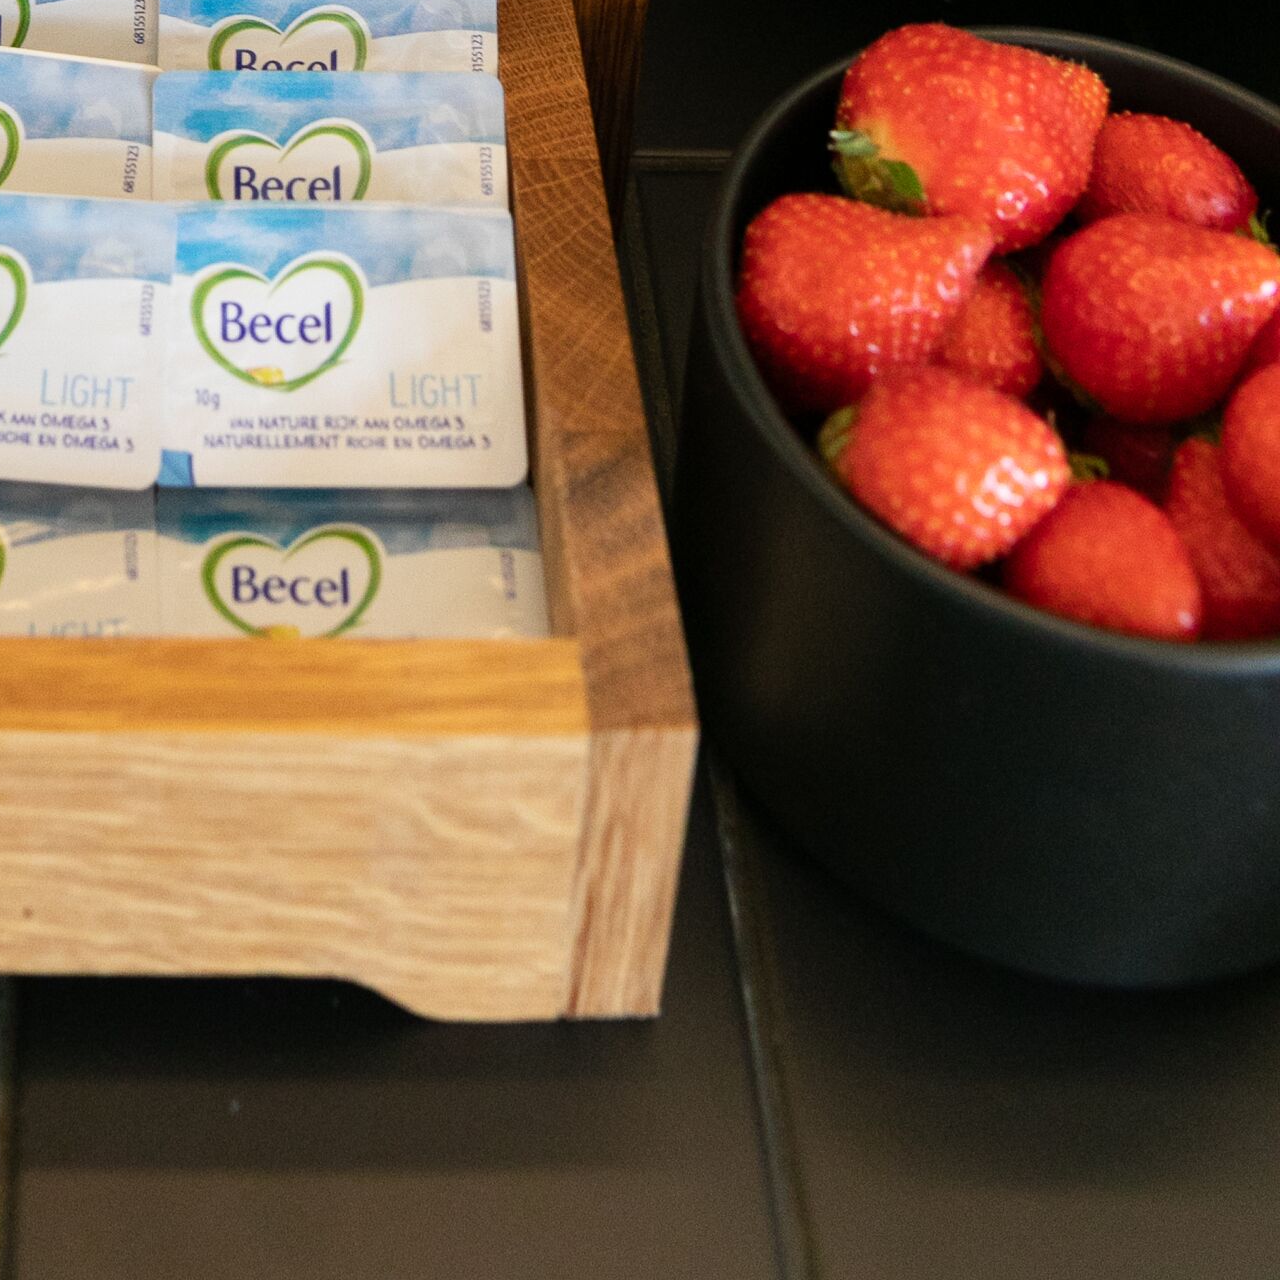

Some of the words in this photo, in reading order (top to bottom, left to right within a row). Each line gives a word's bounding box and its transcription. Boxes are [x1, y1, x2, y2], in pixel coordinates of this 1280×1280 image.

[122, 144, 140, 194] 68155123
[233, 165, 342, 200] Becel
[220, 300, 333, 344] Becel
[40, 369, 135, 410] LIGHT
[195, 388, 220, 409] 10g
[388, 371, 481, 409] LIGHT
[10, 413, 36, 426] AAN
[41, 413, 98, 430] OMEGA
[258, 417, 319, 431] NATURE
[363, 418, 389, 431] AAN
[394, 417, 451, 431] OMEGA
[38, 433, 57, 448] EN
[62, 433, 119, 451] OMEGA
[204, 434, 341, 450] NATURELLEMENT
[345, 436, 387, 450] RICHE
[393, 436, 413, 450] EN
[417, 435, 477, 450] OMEGA
[230, 564, 350, 606] Becel
